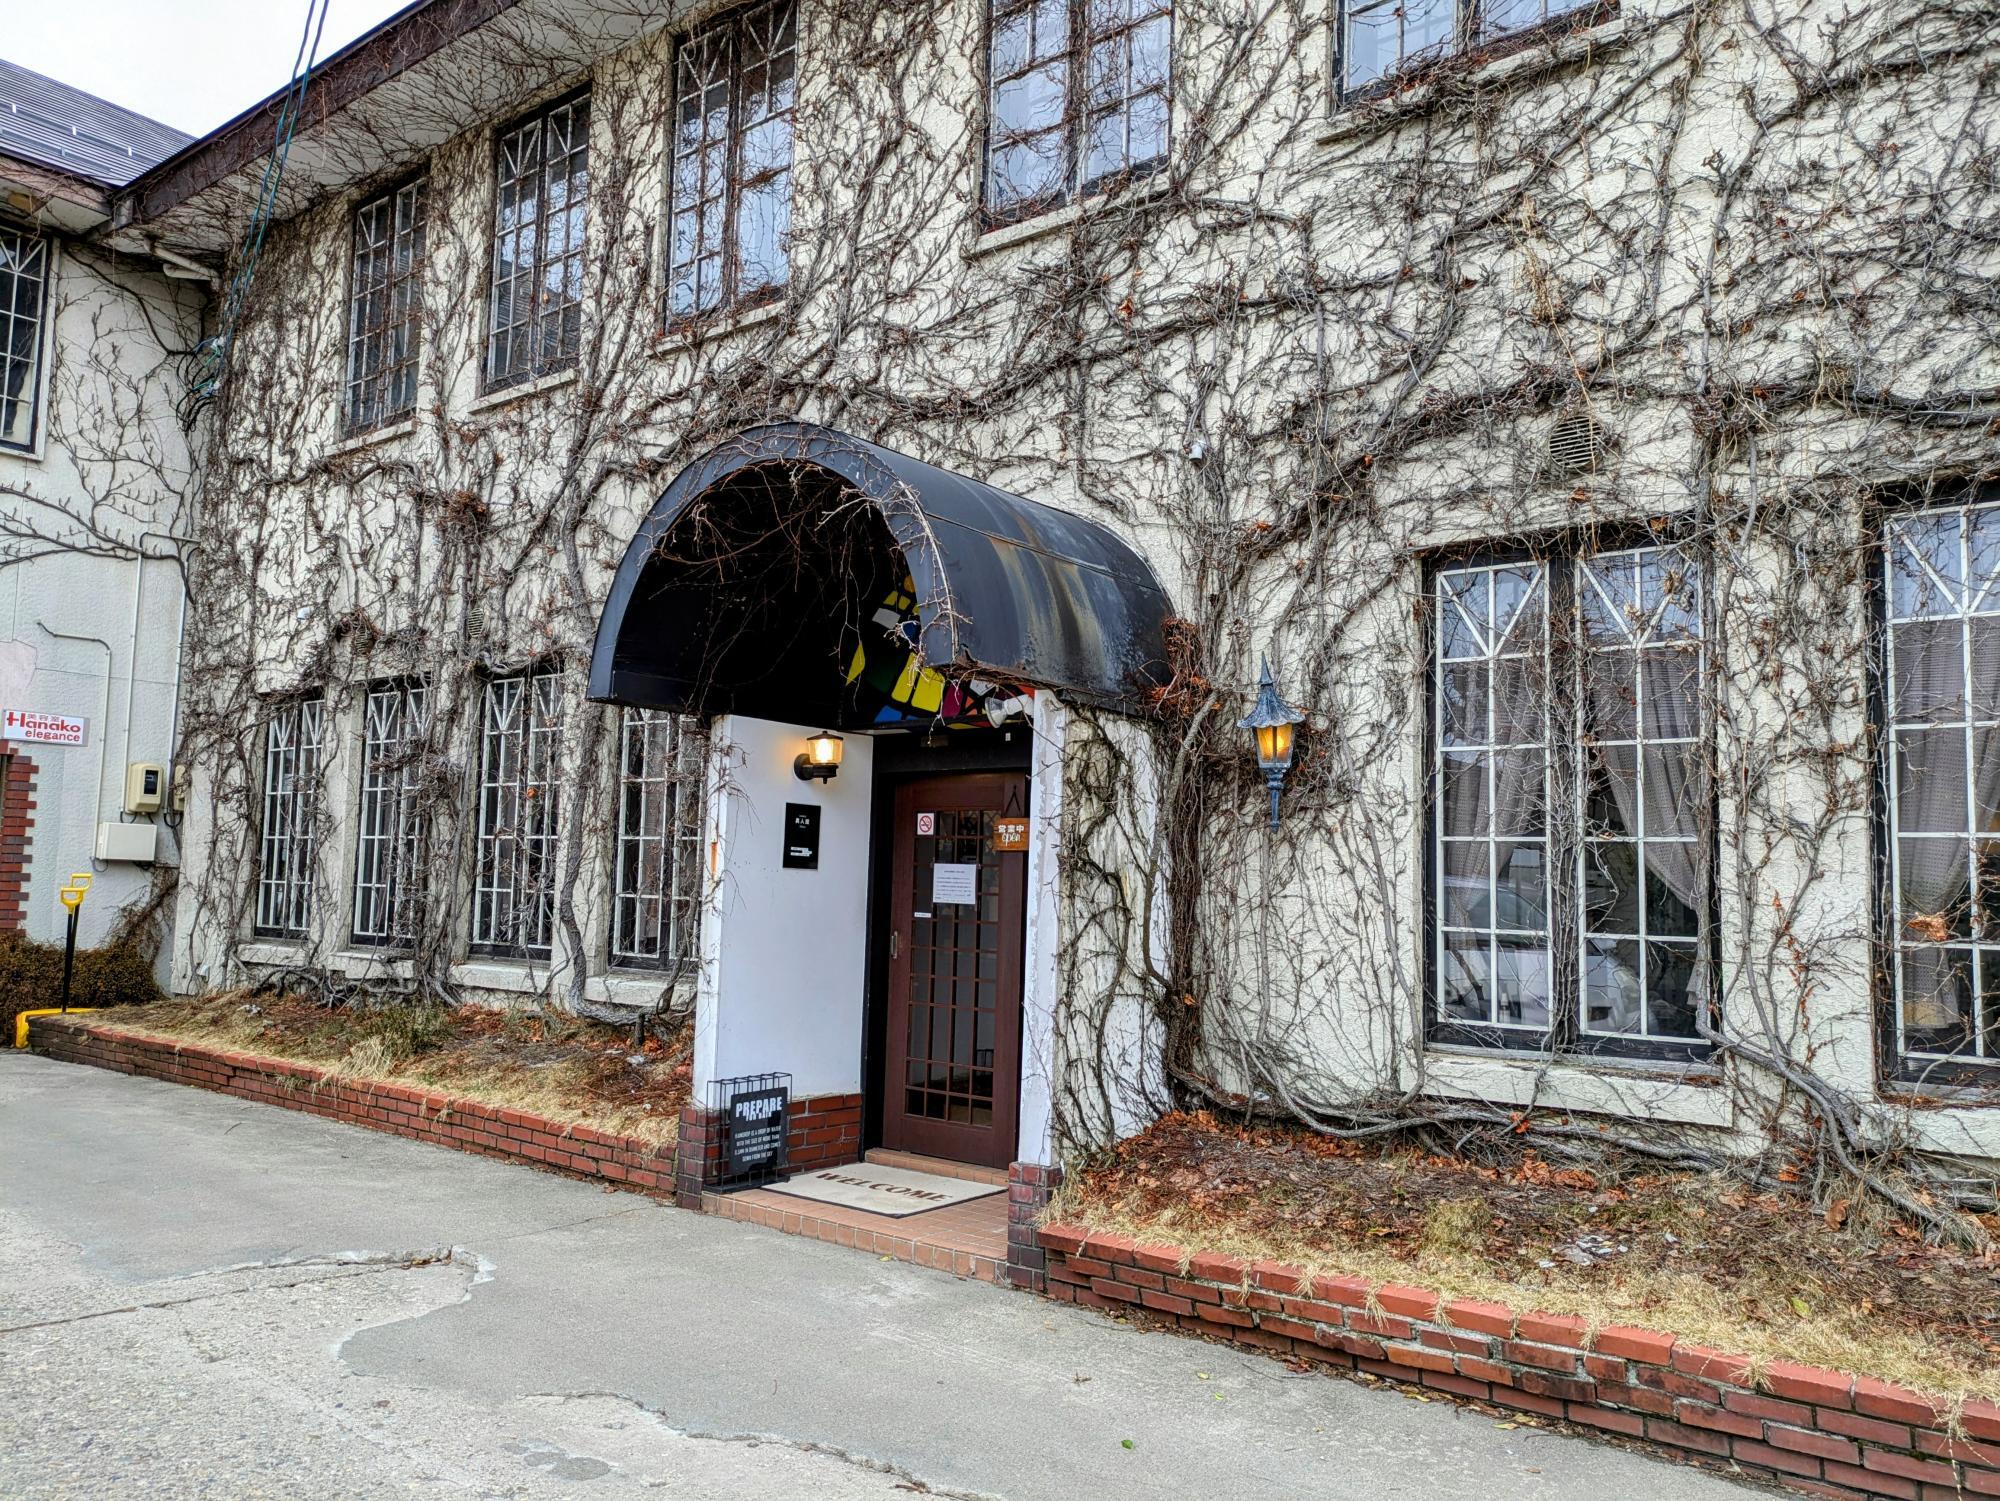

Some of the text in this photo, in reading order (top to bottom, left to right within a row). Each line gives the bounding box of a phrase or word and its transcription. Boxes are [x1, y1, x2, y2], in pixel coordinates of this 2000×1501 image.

[7, 711, 81, 733] Hanako
[25, 729, 80, 742] elegance
[998, 824, 1025, 833] 営業中
[736, 1097, 782, 1118] PREPARE
[816, 1172, 952, 1202] WELCOME
